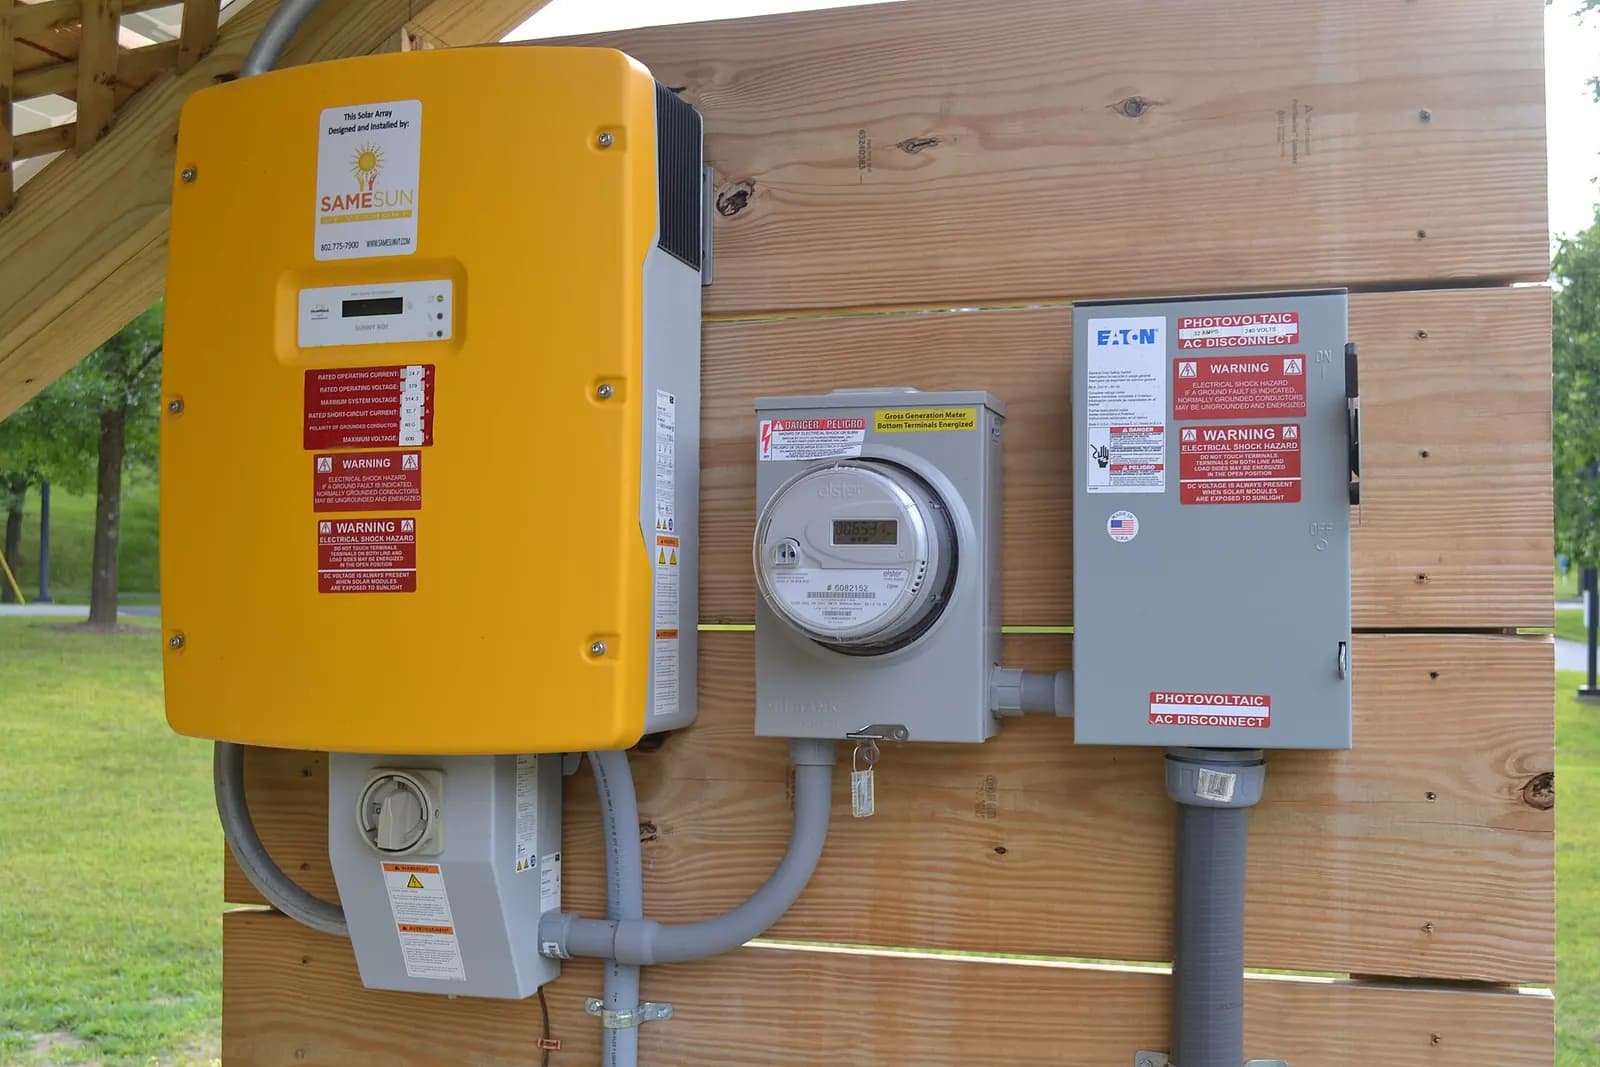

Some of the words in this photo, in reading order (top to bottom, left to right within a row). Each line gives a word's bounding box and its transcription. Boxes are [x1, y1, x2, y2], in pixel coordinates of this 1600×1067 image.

[358, 111, 373, 119] Solar
[375, 110, 392, 118] Array
[328, 125, 356, 135] Designed
[357, 123, 369, 131] and
[370, 121, 397, 130] Installed
[400, 120, 409, 128] by:
[321, 189, 413, 212] SAMESUN
[1184, 313, 1292, 328] PHOTOVOLTAIC
[1097, 329, 1155, 345] EATON
[1184, 339, 1202, 348] AC
[1206, 335, 1293, 348] DISCONNECT
[1315, 350, 1331, 363] ON
[1211, 363, 1270, 374] WARNING
[1200, 402, 1249, 410] UNGROUNDED
[785, 421, 819, 430] DANGER
[826, 419, 862, 429] PELIGRO
[938, 421, 973, 429] Energized
[1203, 429, 1275, 440] WARNING
[342, 458, 391, 469] WARNING
[336, 521, 395, 533] WARNING
[1155, 694, 1264, 706] PHOTOVOLTAIC
[1155, 715, 1173, 724] AC
[1177, 715, 1264, 727] DISCONNECT
